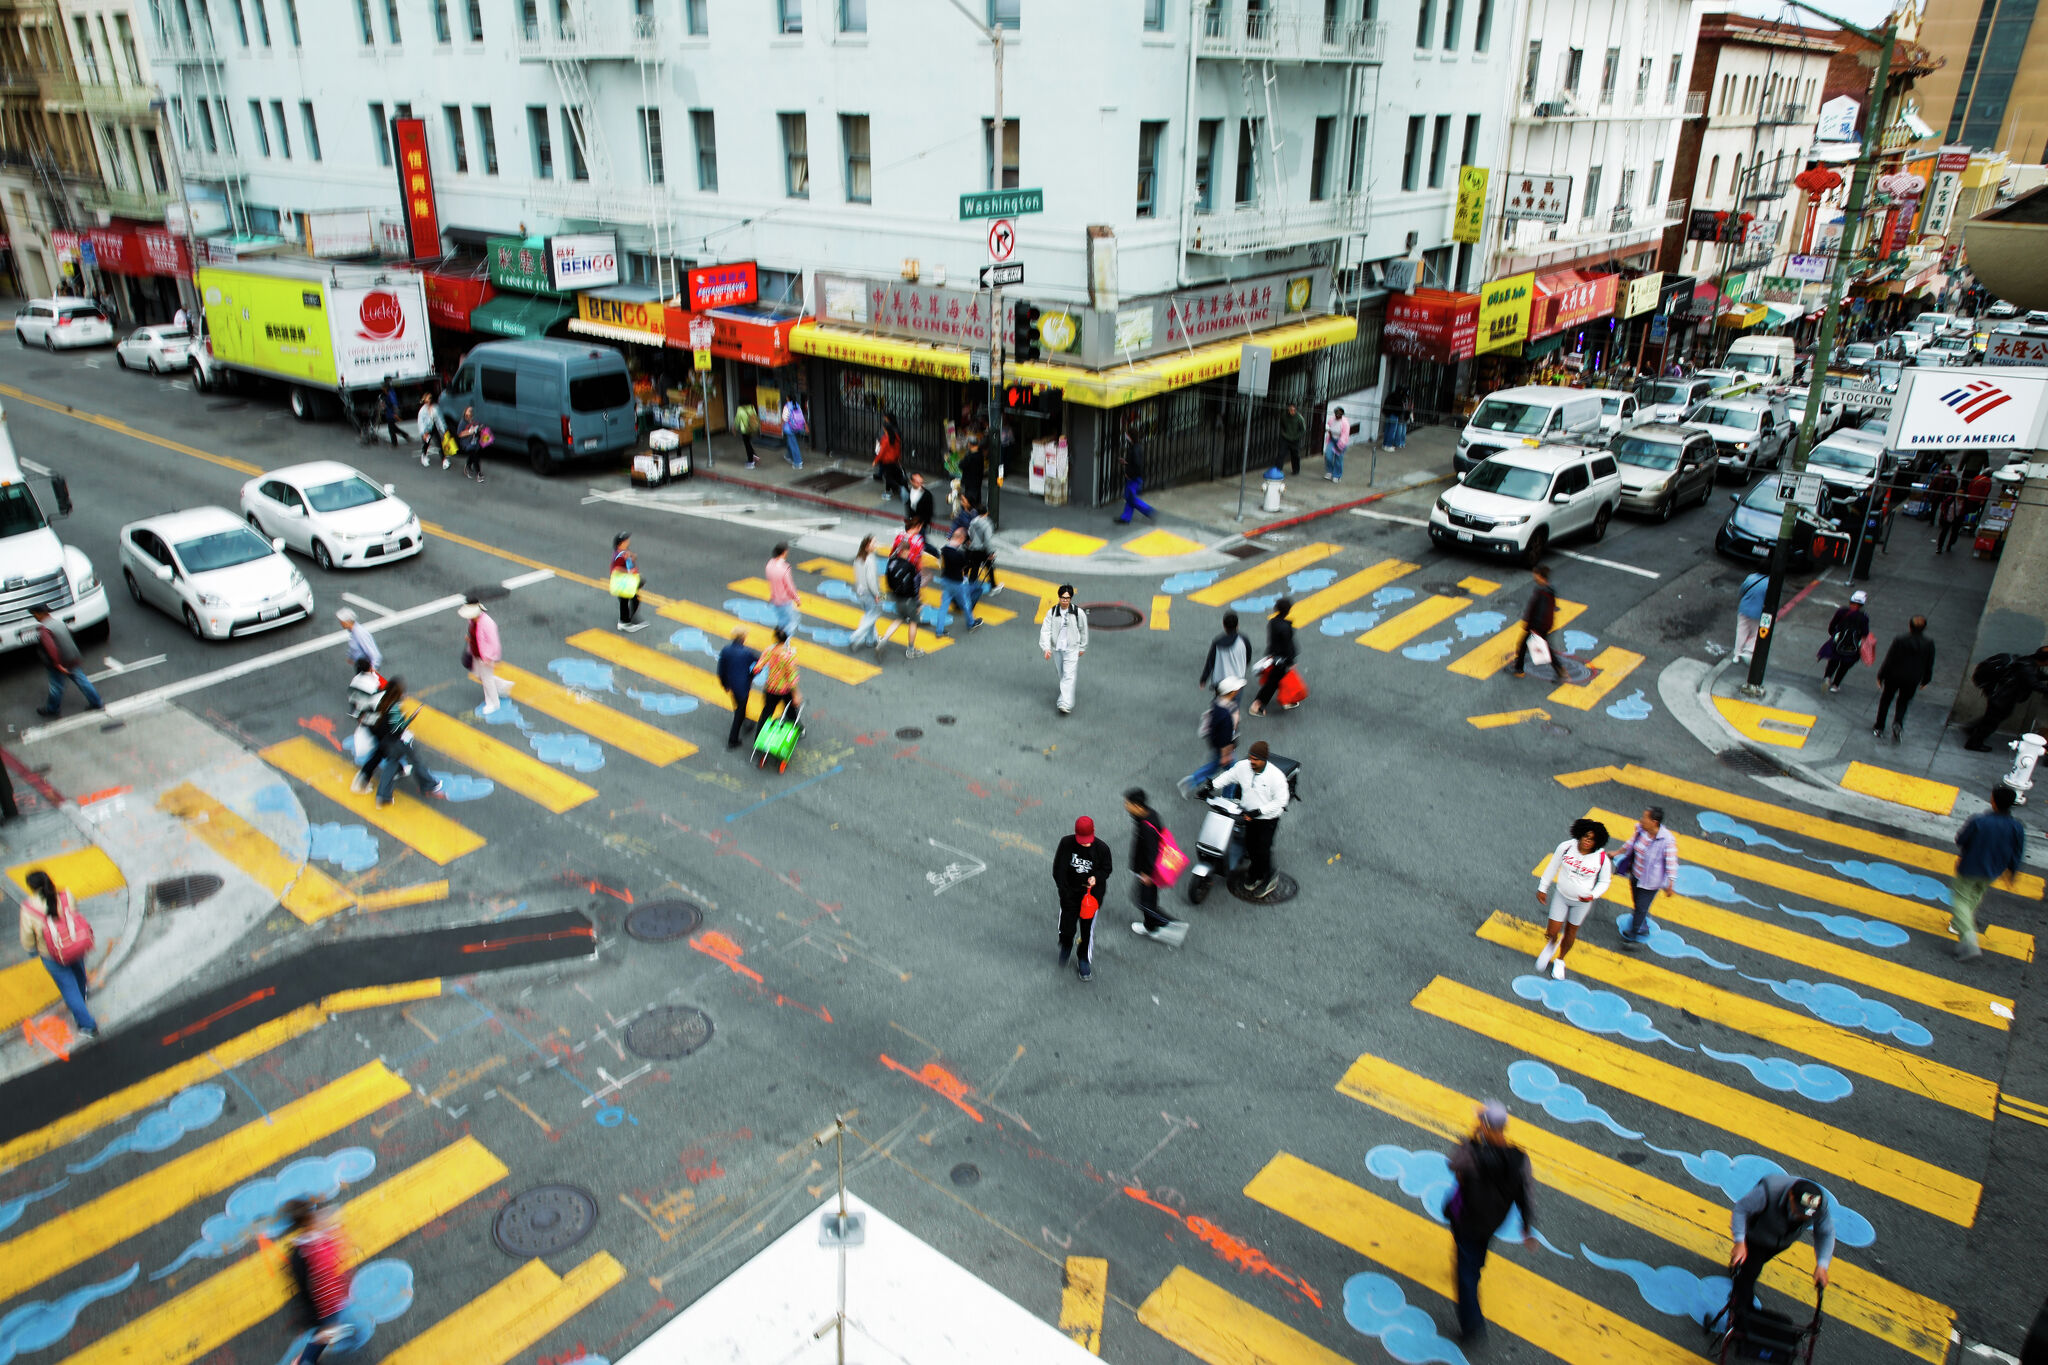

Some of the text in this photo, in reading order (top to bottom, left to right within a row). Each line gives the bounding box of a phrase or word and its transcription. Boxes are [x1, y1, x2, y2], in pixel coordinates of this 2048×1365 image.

[965, 194, 1039, 215] Washington
[561, 253, 614, 274] BENCO
[993, 265, 1021, 283] ONE WAY
[362, 294, 400, 331] Lucky
[589, 298, 648, 327] BENCO
[897, 315, 908, 328] M
[1186, 324, 1194, 337] M
[1250, 307, 1270, 322] INC
[1832, 391, 1892, 406] STOCKTON
[1911, 433, 2016, 444] BANK OF AMERICA
